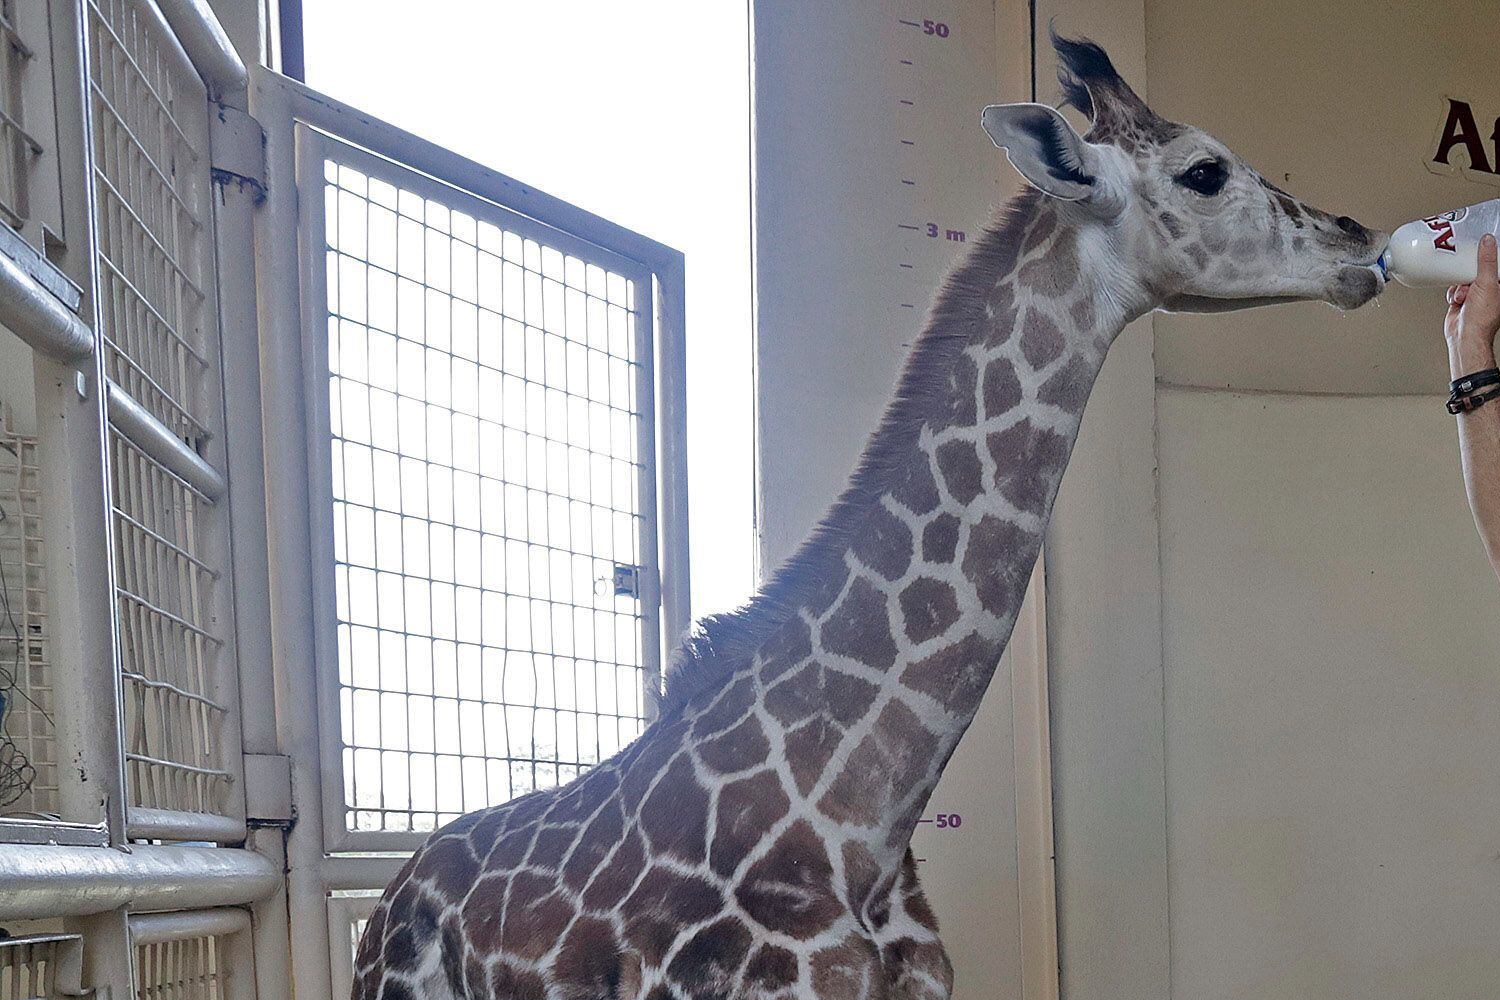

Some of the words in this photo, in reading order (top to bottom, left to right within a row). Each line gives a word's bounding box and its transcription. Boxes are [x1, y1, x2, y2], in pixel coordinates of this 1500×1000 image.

[923, 19, 950, 38] 50
[926, 222, 939, 239] 3
[946, 228, 966, 243] m
[936, 814, 962, 829] 50
